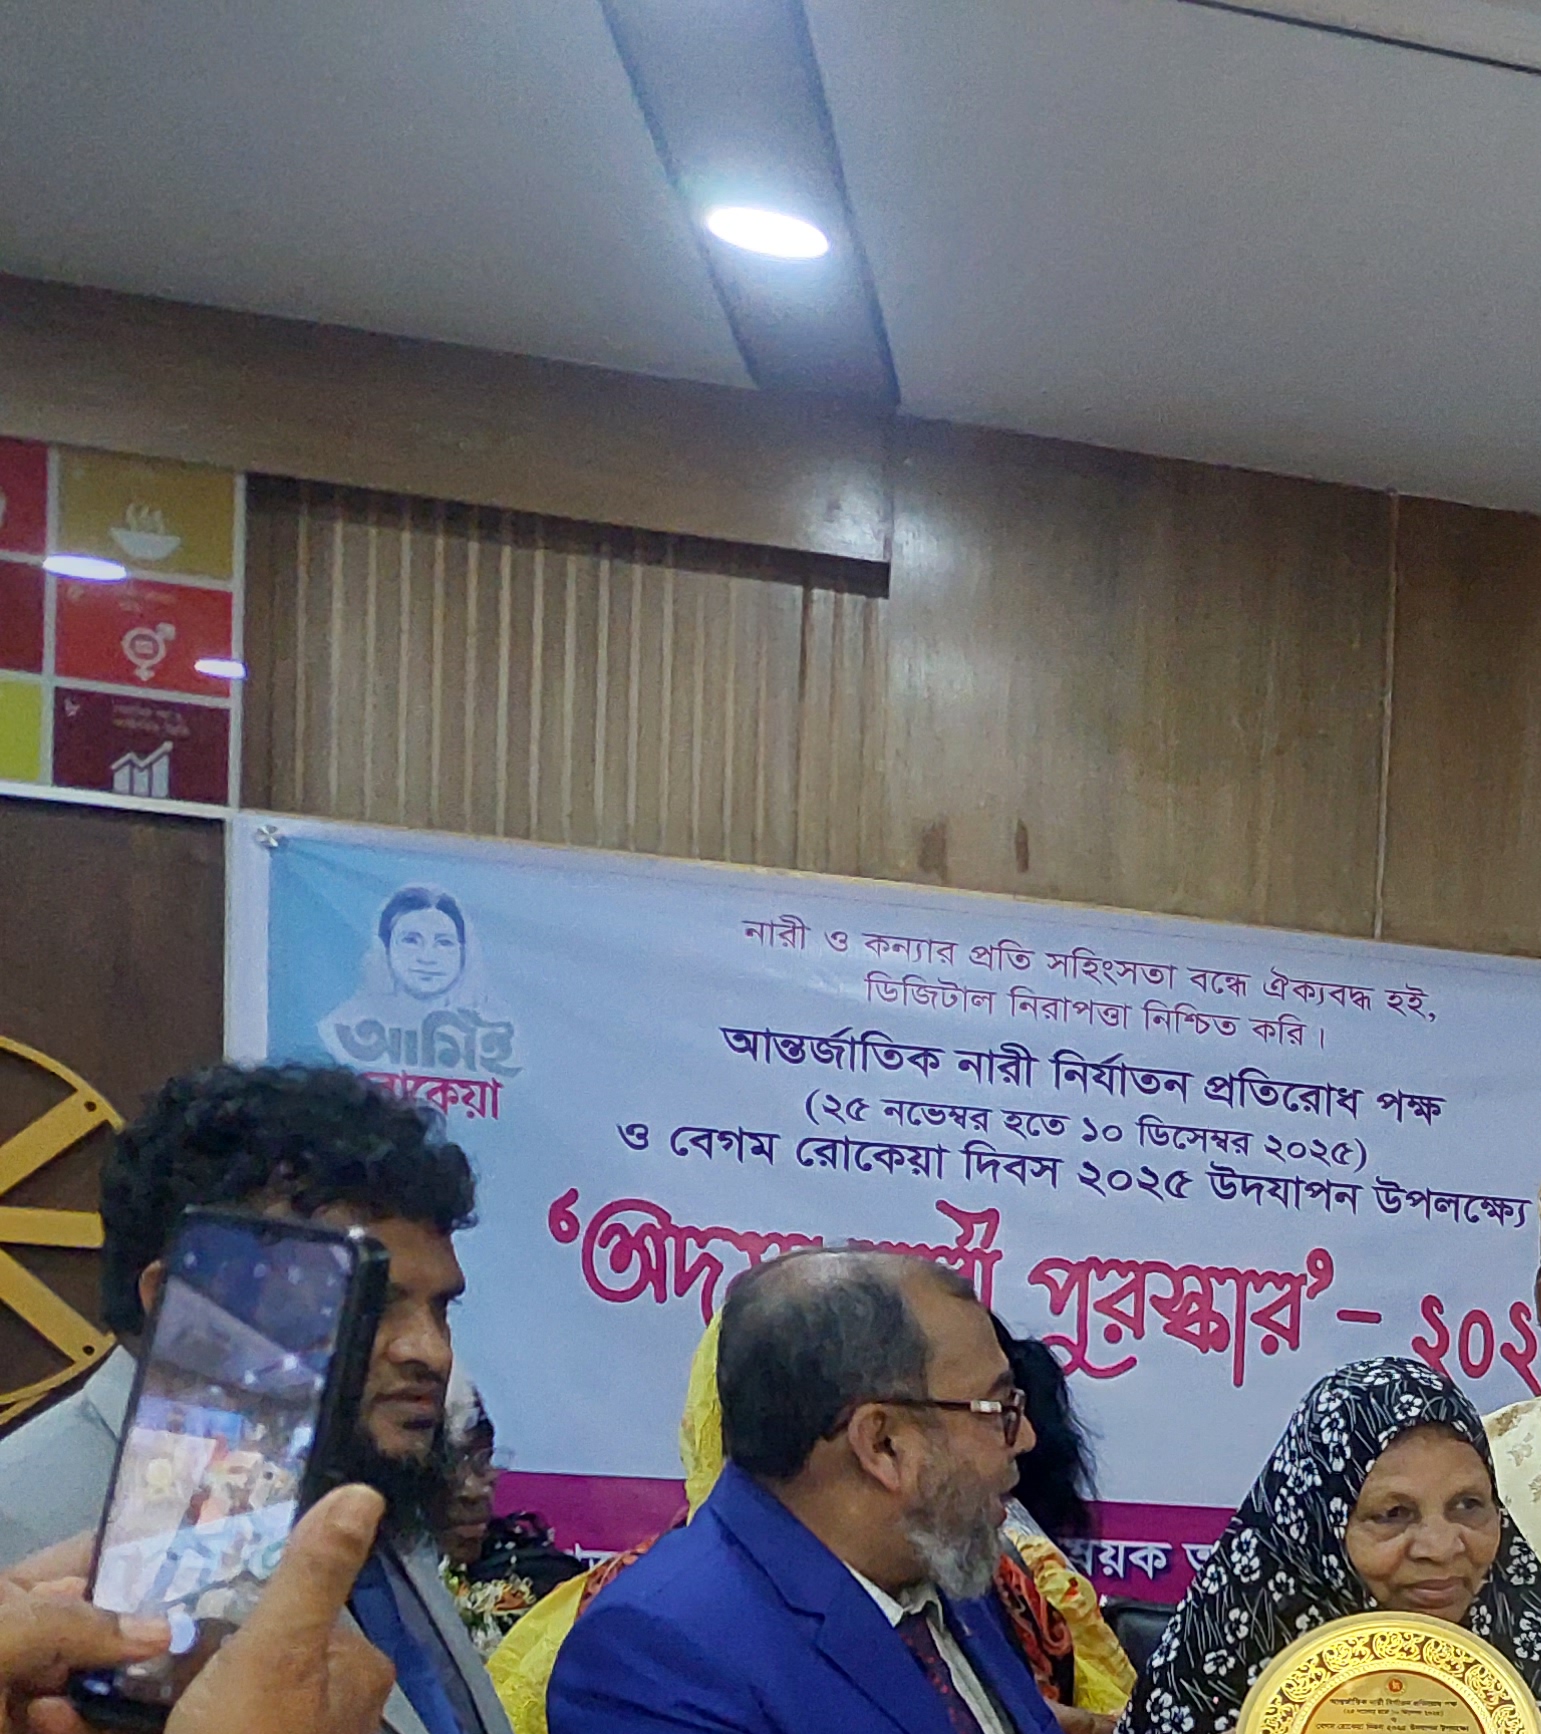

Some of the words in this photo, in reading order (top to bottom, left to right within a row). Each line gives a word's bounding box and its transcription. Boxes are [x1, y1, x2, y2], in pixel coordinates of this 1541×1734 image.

[742, 914, 810, 950] নারী
[826, 931, 848, 953] ও
[861, 932, 958, 967] কন্যার
[970, 938, 1035, 972] প্রতি
[1046, 946, 1178, 986] সহিংসতা
[1187, 966, 1251, 998] বন্ধে
[1263, 966, 1375, 1012] ঐক্যবদ্ধ
[1384, 983, 1438, 1023] হই,
[863, 970, 997, 1015] ডিজিটাল
[1007, 986, 1133, 1030] নিরাপত্তা
[1143, 999, 1240, 1037] নিশ্চিত
[719, 1026, 946, 1078] আন্তর্জাতিক
[954, 1042, 1040, 1088] নারী
[1048, 1050, 1194, 1104] নির্যাতন
[1203, 1067, 1366, 1120] প্রতিরোধ
[1375, 1089, 1448, 1127] পক্ষ
[617, 1122, 650, 1152] ও
[669, 1124, 782, 1167] বেগম
[795, 1135, 952, 1180] রোকেয়া
[960, 1138, 1064, 1191] দিবস
[1077, 1158, 1195, 1202] ২০২৫
[1206, 1160, 1365, 1215] উদযাপন
[1371, 1173, 1533, 1230] উপলক্ষ্যে
[805, 1088, 871, 1127] (২৫
[879, 1098, 992, 1134] নভেম্বর
[1000, 1108, 1072, 1140] হতে
[1081, 1116, 1124, 1145] ১০
[1134, 1113, 1254, 1158] ডিসেম্বর
[1264, 1132, 1368, 1174] ২০২৫)
